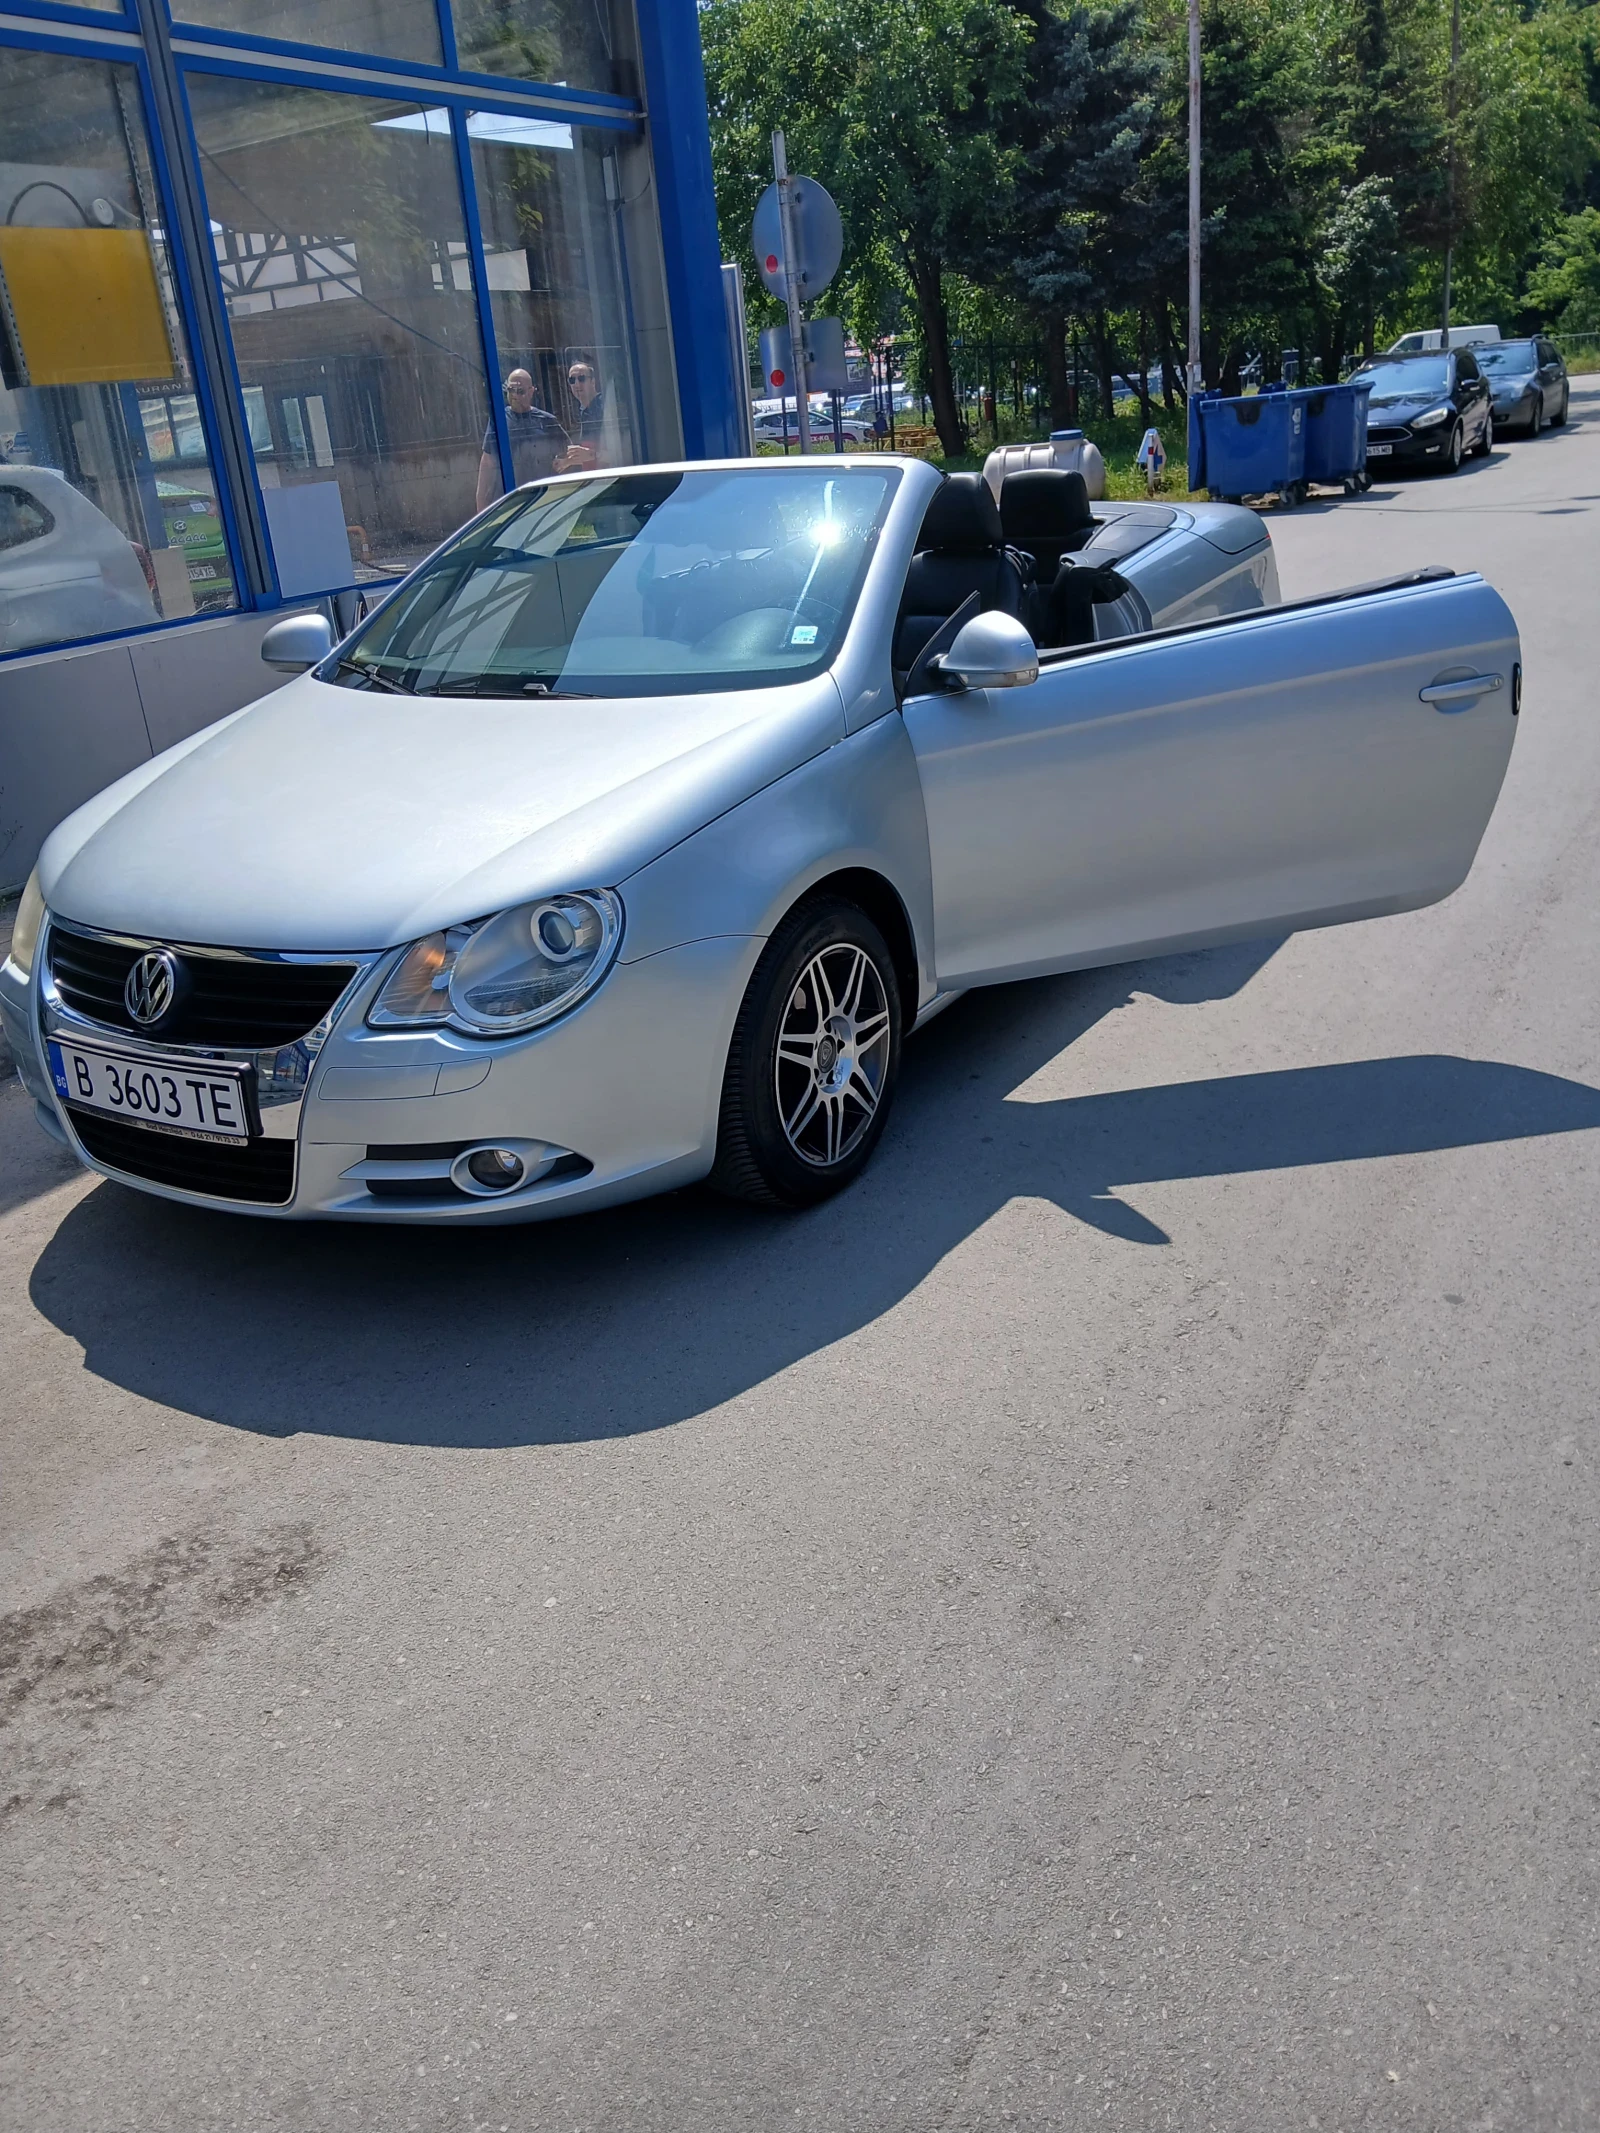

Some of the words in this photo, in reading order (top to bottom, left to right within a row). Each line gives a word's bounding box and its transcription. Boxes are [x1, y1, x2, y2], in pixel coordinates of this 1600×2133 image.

[56, 1074, 67, 1089] BG
[73, 1055, 94, 1098] B
[105, 1065, 182, 1118] 3603
[186, 1079, 237, 1128] TE
